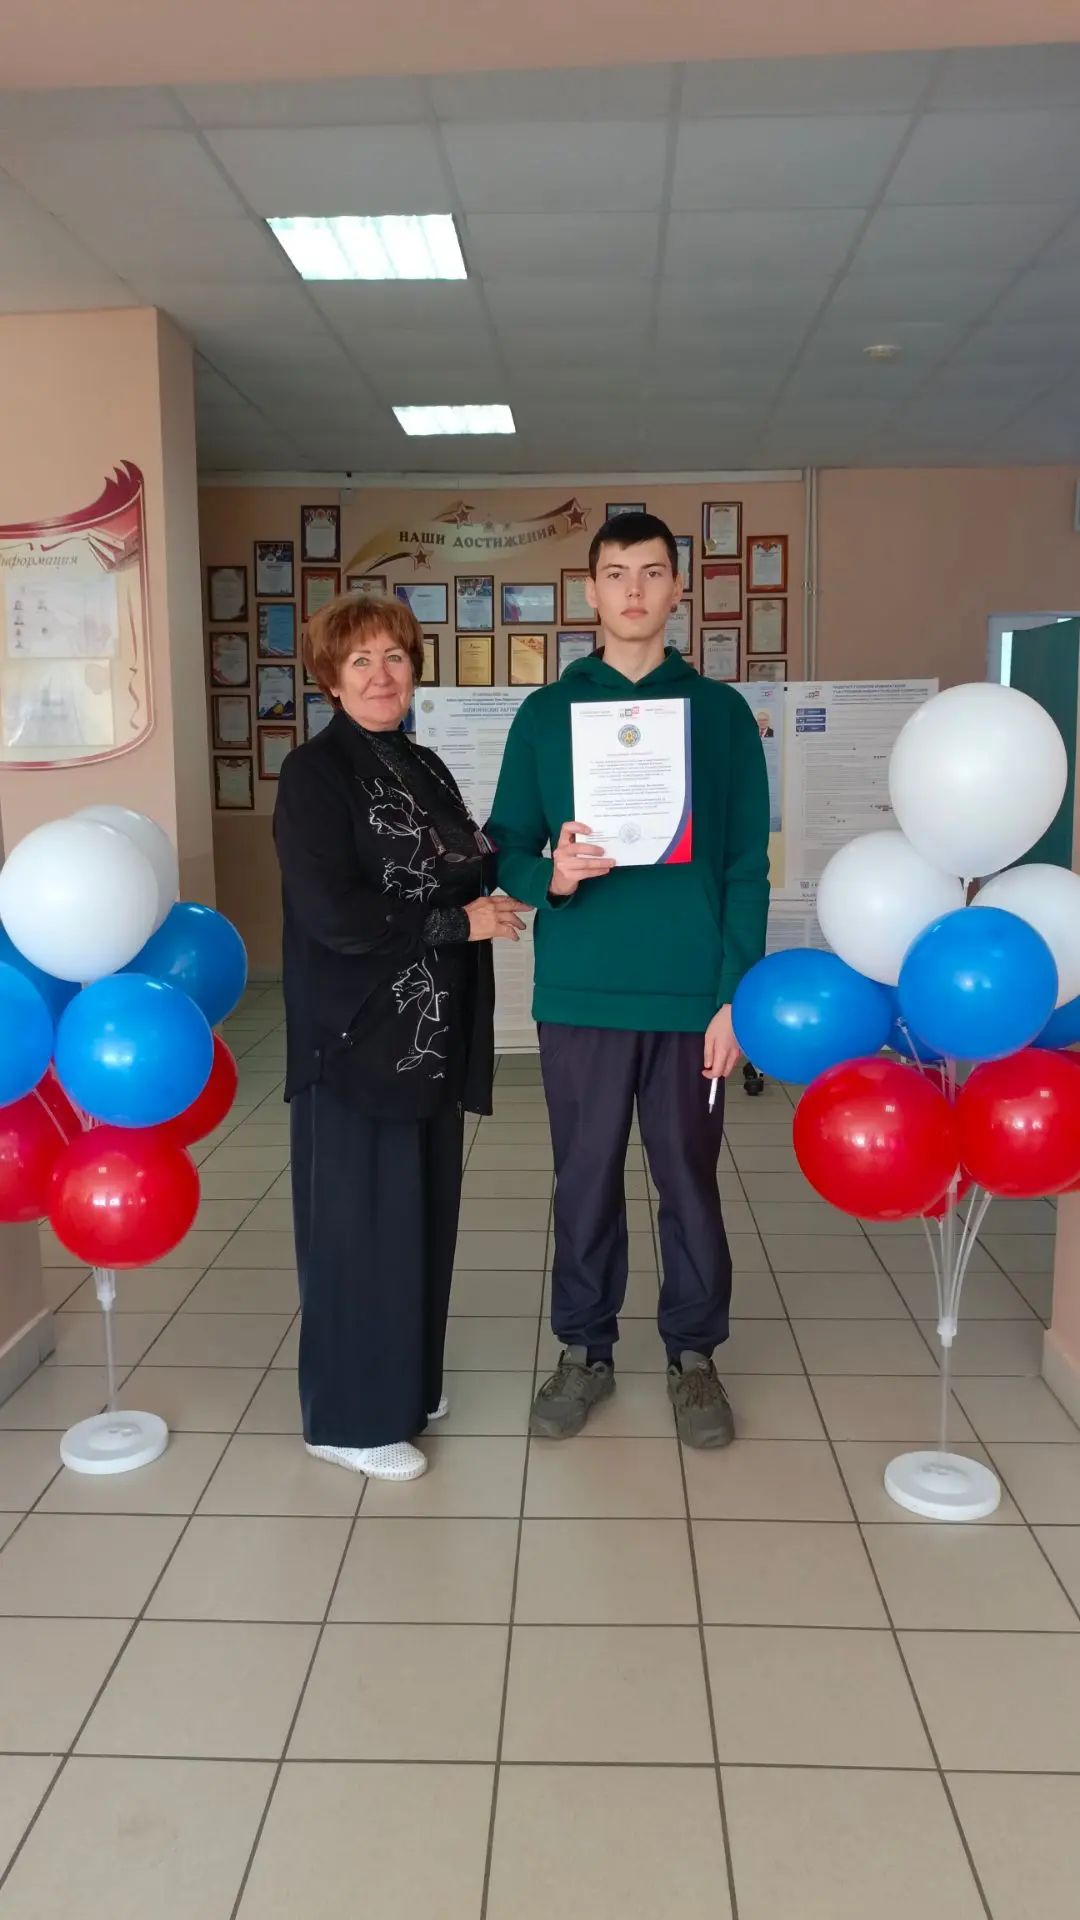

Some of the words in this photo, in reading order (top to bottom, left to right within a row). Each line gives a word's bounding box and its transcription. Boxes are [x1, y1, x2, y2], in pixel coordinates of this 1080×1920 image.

[399, 531, 445, 545] НАШИ
[452, 524, 557, 548] ДОСТИЖЕНИЯ
[0, 553, 79, 569] нформация
